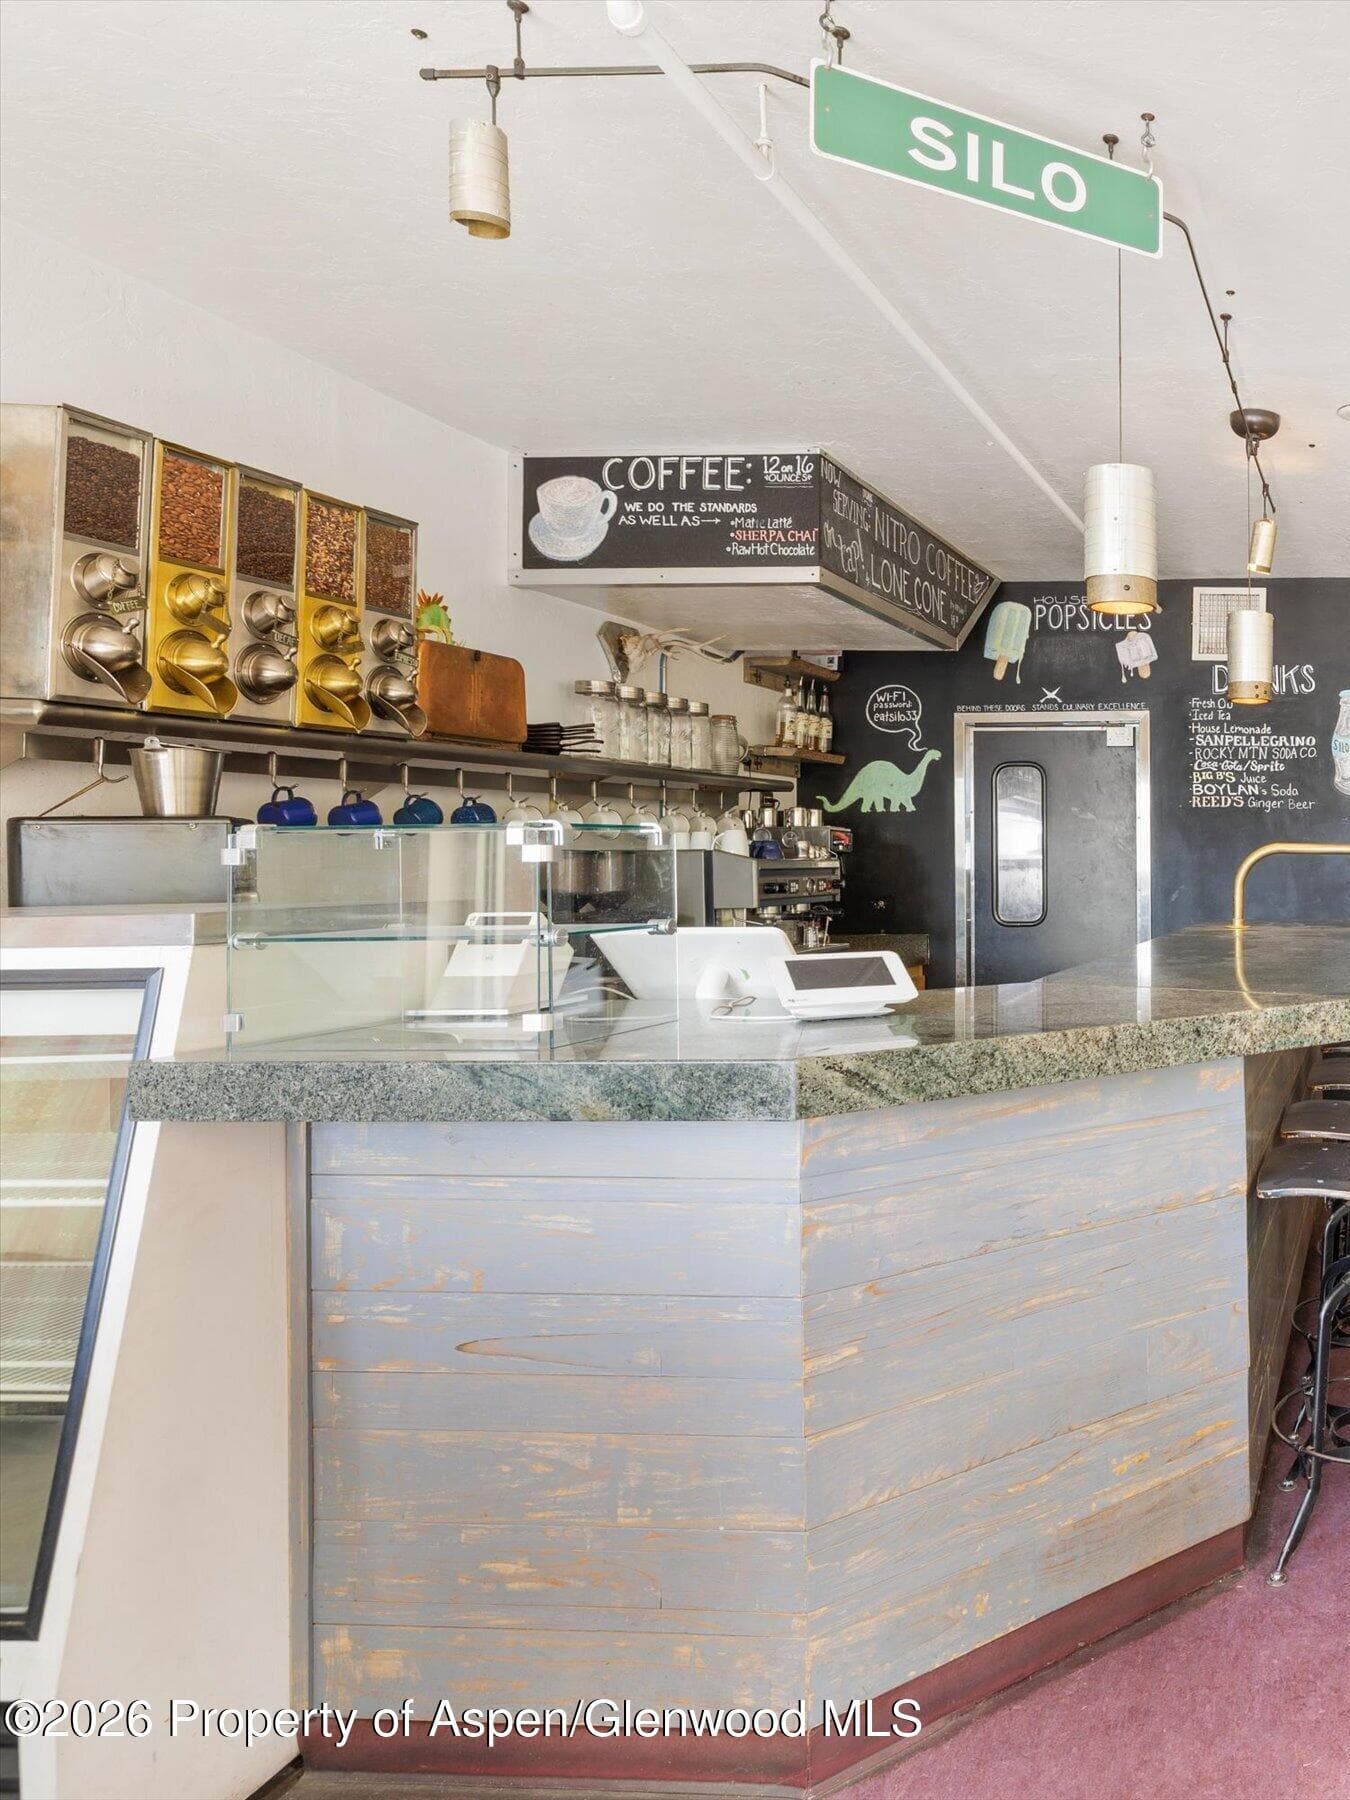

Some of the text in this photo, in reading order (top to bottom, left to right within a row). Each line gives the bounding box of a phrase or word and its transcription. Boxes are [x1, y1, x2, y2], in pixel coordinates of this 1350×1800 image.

[906, 116, 1087, 212] SILO
[763, 455, 780, 474] 12
[795, 455, 814, 474] 16
[602, 456, 752, 491] COFFEE:
[821, 458, 842, 488] NOW
[624, 502, 757, 513] WE DO THE STANDARDS
[618, 515, 700, 526] AS WELL AS
[735, 529, 786, 543] SHERPA
[731, 542, 816, 556] Raw Hot Chocolate
[833, 489, 979, 604] SERVING: NITRO COFFEE
[870, 553, 911, 605] LONE
[914, 577, 947, 624] CONE
[1034, 595, 1088, 605] HOUSE
[1034, 604, 1151, 631] POPSICLES
[1212, 664, 1316, 695] DNKS
[876, 690, 906, 702] WI-FI
[1191, 697, 1216, 708] Fresh
[983, 704, 1003, 712] THESE
[1032, 703, 1059, 711] STANDS
[1062, 702, 1095, 711] CULINARY
[1097, 702, 1148, 711] EXCELLENCE
[873, 710, 917, 722] eatsilo33
[1191, 709, 1231, 721] Iced Tea
[1191, 722, 1272, 734] House Lemonade
[1195, 734, 1317, 747] SANPELLEGRINO
[1194, 746, 1235, 760] ROCKY
[1238, 746, 1268, 759] MTN
[1272, 747, 1297, 759] SODA
[1192, 771, 1213, 783] BIG
[1240, 772, 1267, 783] Juice
[1271, 783, 1299, 796] Soda
[1192, 796, 1316, 812] REED'S Ginger Beer
